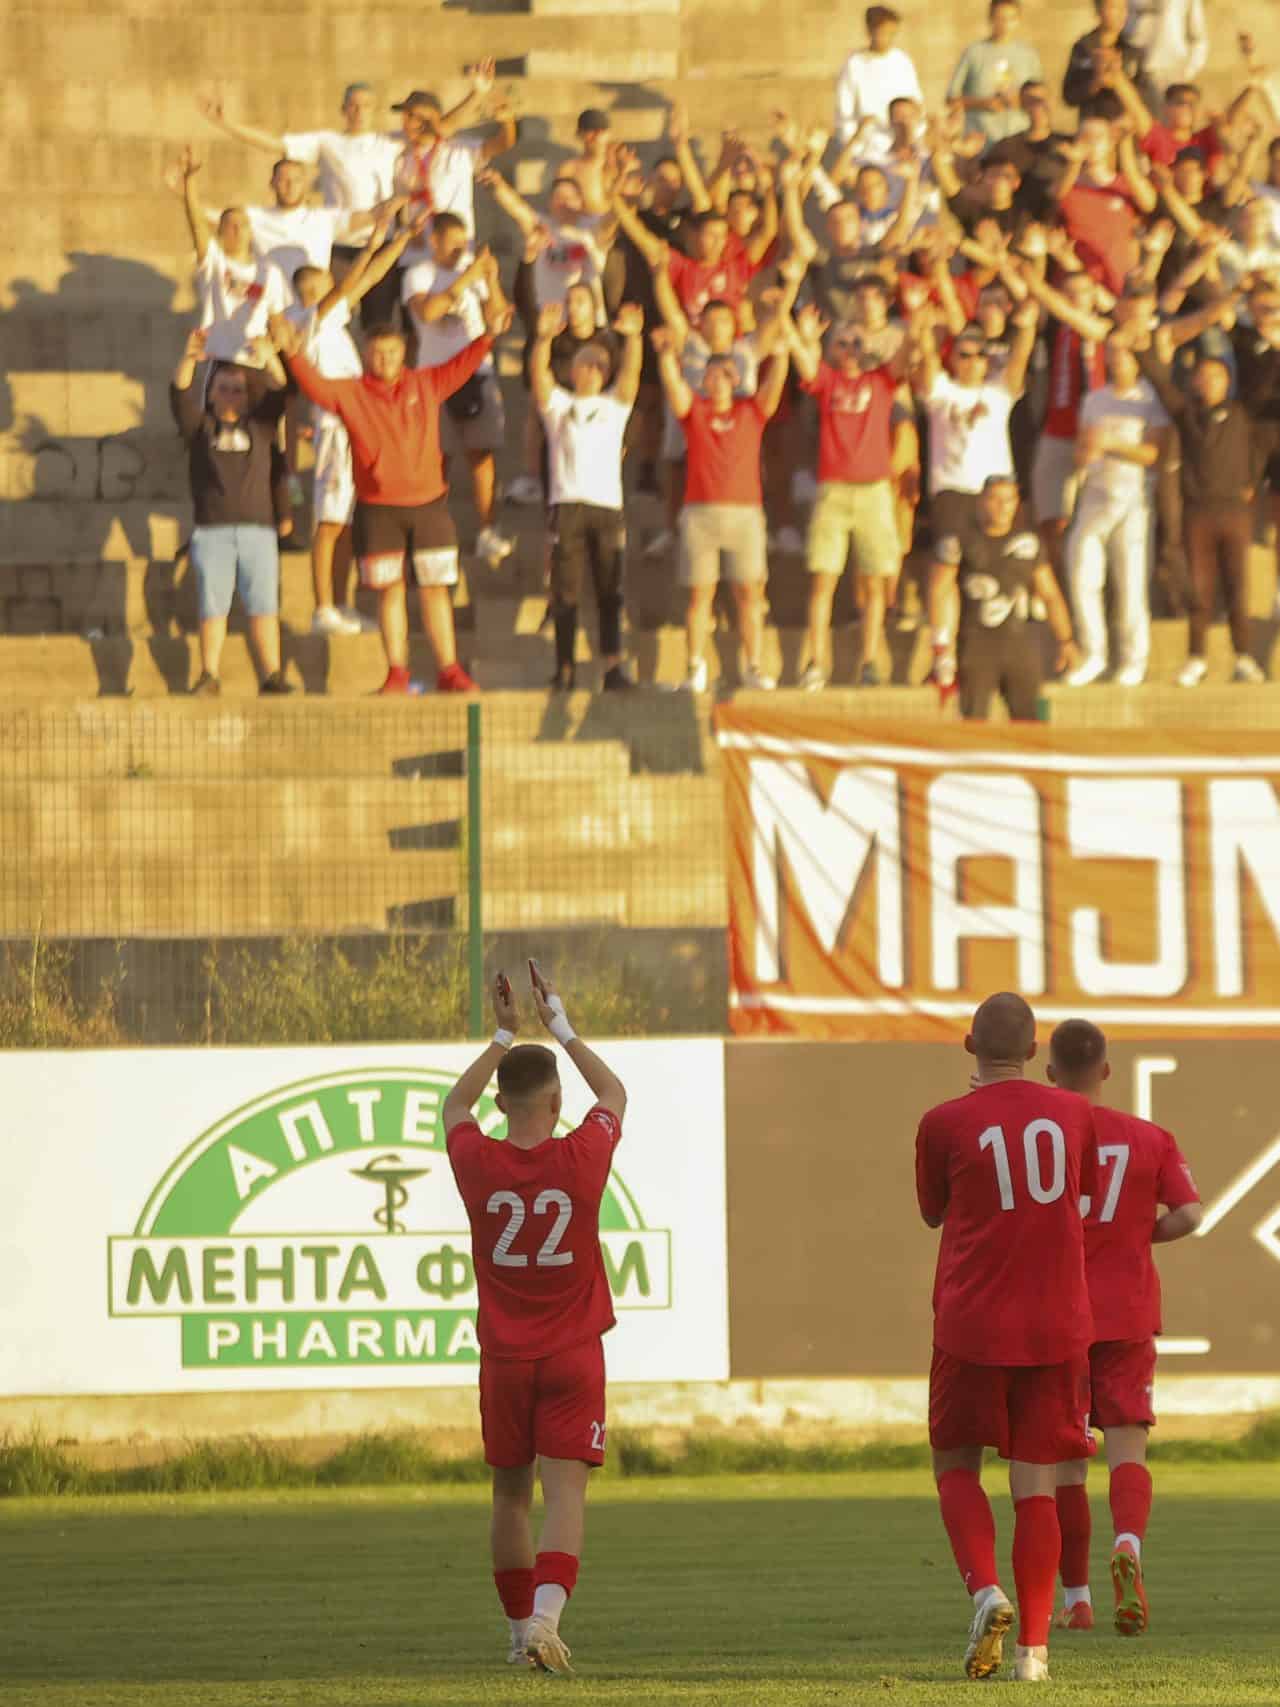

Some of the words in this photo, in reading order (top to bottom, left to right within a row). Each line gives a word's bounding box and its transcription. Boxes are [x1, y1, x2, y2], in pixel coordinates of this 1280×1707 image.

[978, 1118, 1067, 1211] 10
[1079, 1144, 1131, 1223] 7
[485, 1188, 575, 1268] 22
[125, 1242, 388, 1306] МЕНТА
[416, 1239, 652, 1302] ФМ
